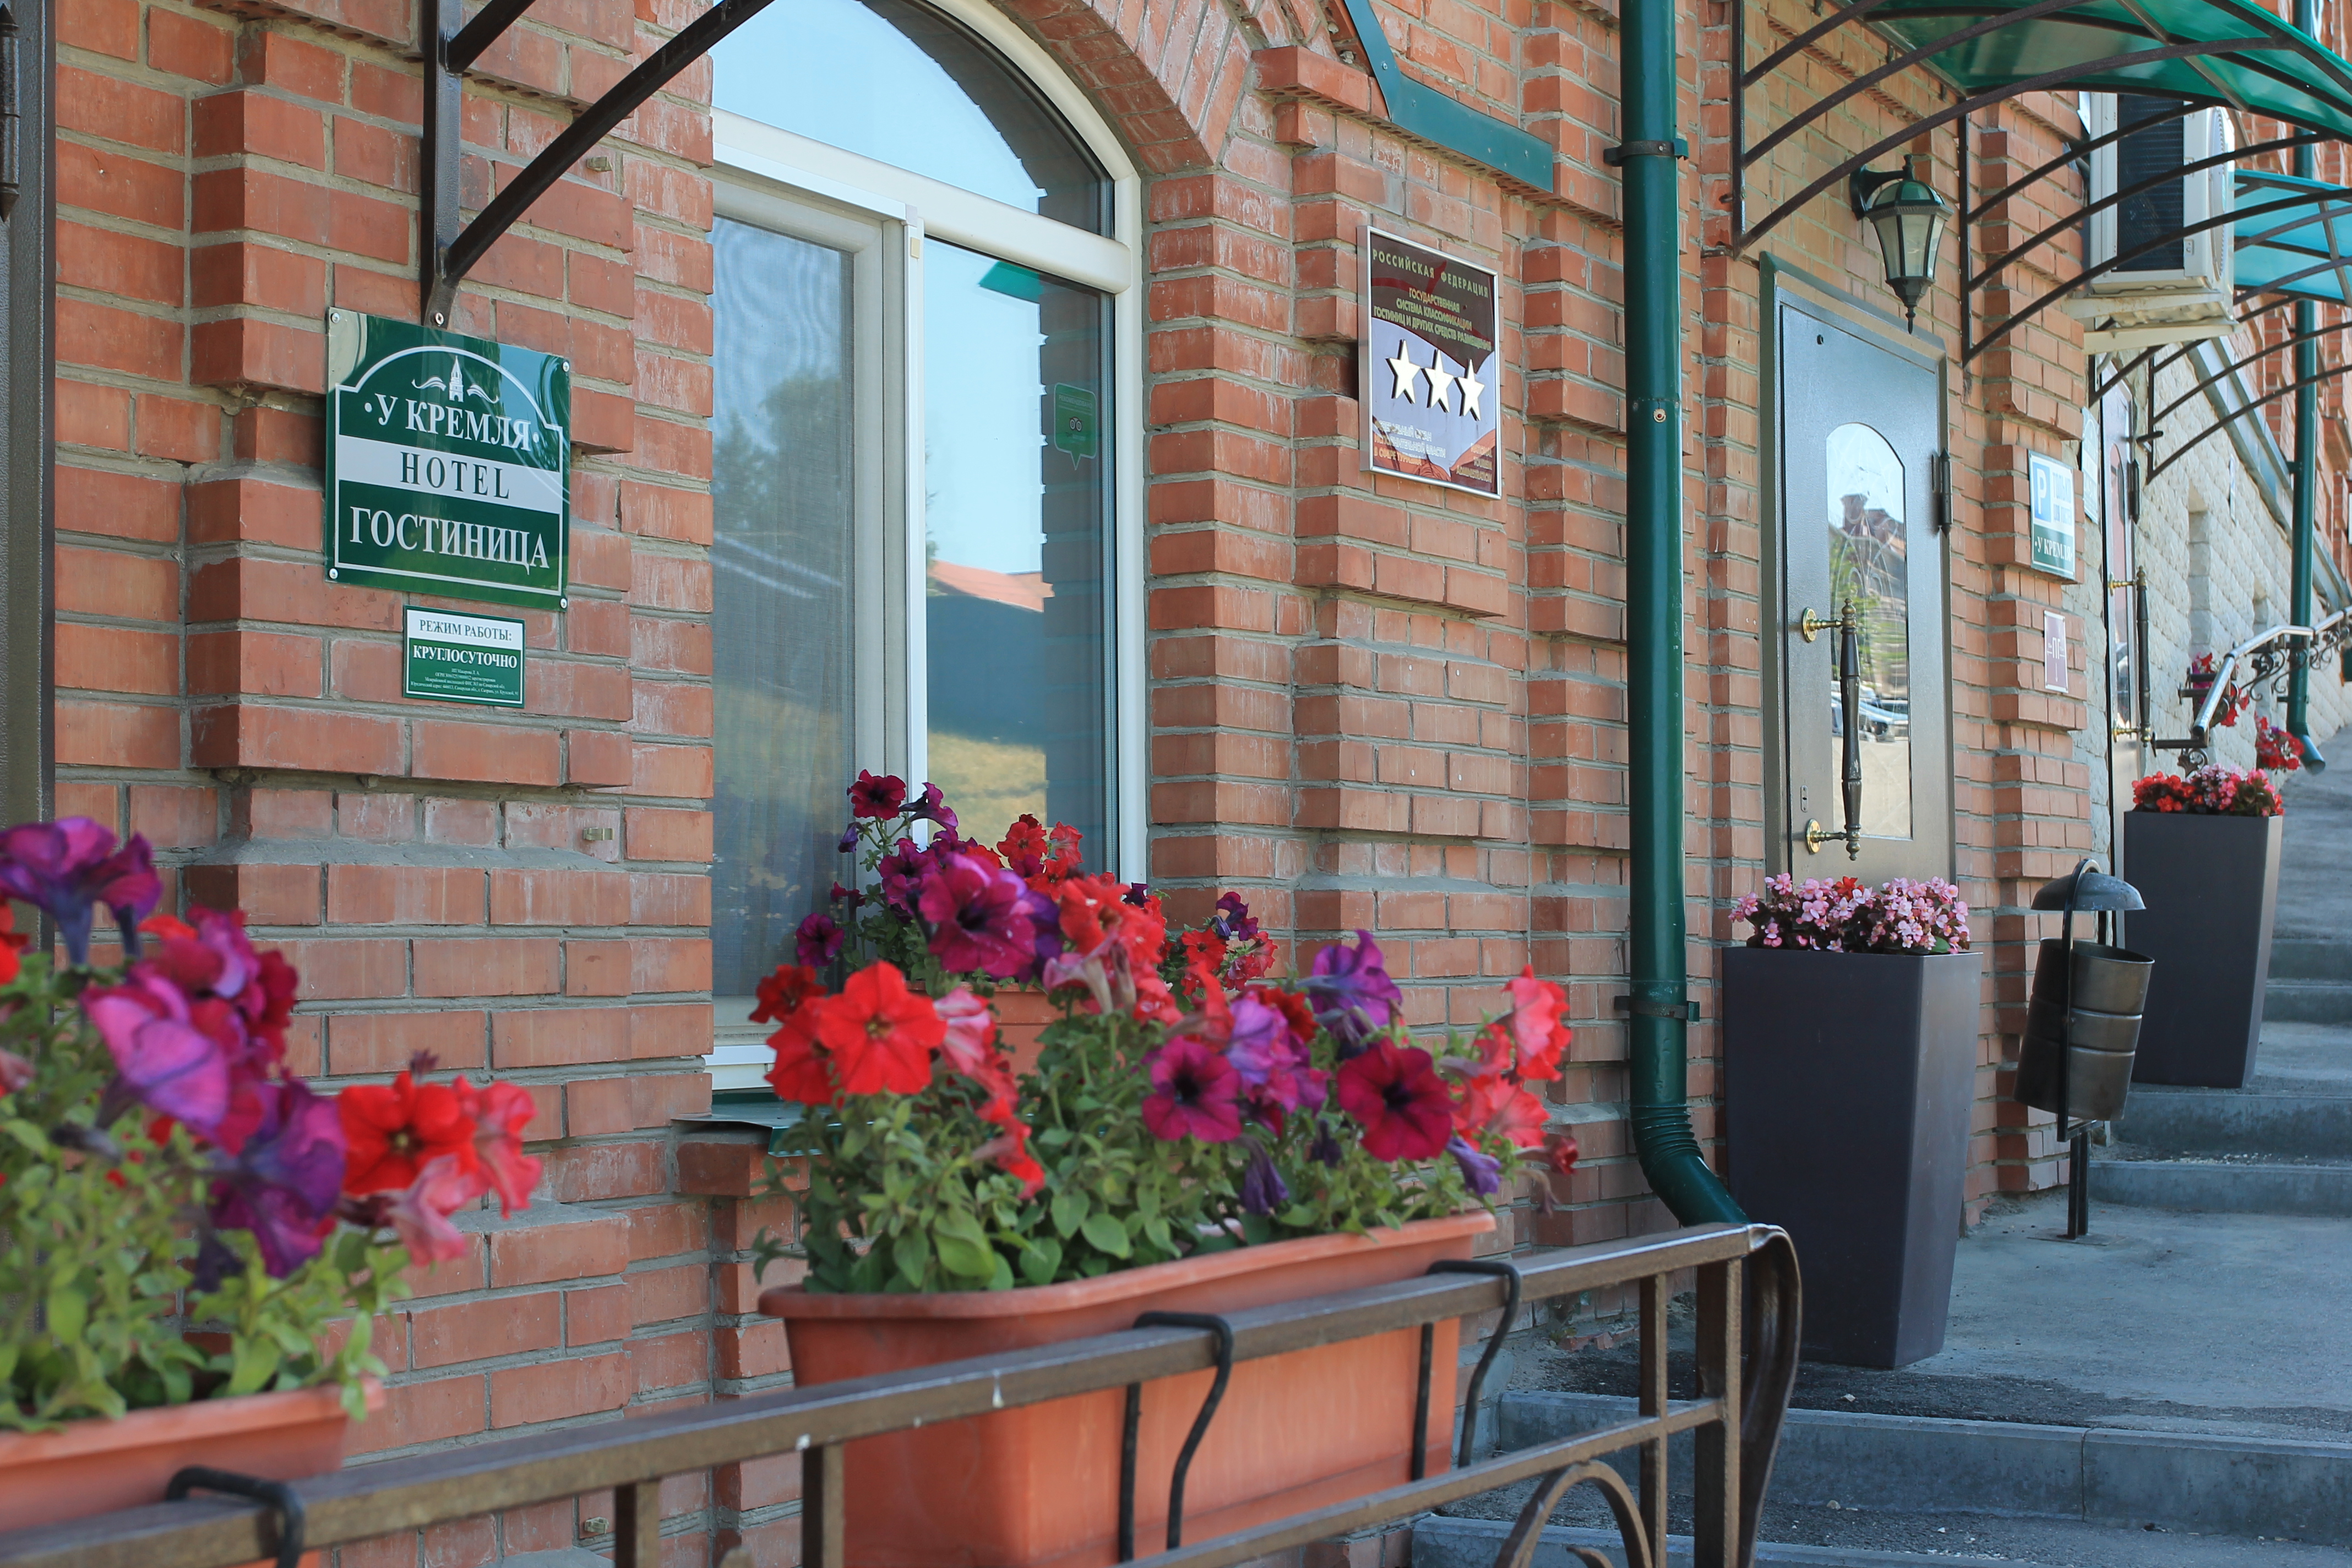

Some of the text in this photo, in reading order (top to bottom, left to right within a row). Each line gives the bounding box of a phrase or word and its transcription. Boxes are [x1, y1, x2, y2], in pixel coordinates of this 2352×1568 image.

[1373, 248, 1489, 298] РОССИЙСКАЯ ФЕДЕРАЦИЯ
[1396, 298, 1472, 331] СИСТЕМА КЛАССИФИКАЦИИ
[1408, 287, 1460, 313] ГОСУДАРСТВЕННАЯ
[1374, 306, 1492, 352] ГОСТИНИЦ И ДРУГИХ СРЕДСТВ РАЗМЕЩЕНИЯ
[374, 393, 531, 451] У КРЕМЛЯ
[400, 451, 509, 499] HOTEL
[1456, 465, 1492, 483] ADMINISTRATION
[2052, 472, 2071, 503] ТОЛЬКО
[350, 506, 549, 575] ГОСТИНИЦА
[2037, 536, 2071, 562] У КРЕМЛЯ
[420, 619, 512, 641] РЕЖИМ РАБОТЫ:
[413, 645, 517, 668] КРУГЛОСУТОЧНО
[2052, 637, 2060, 660] ПГ
